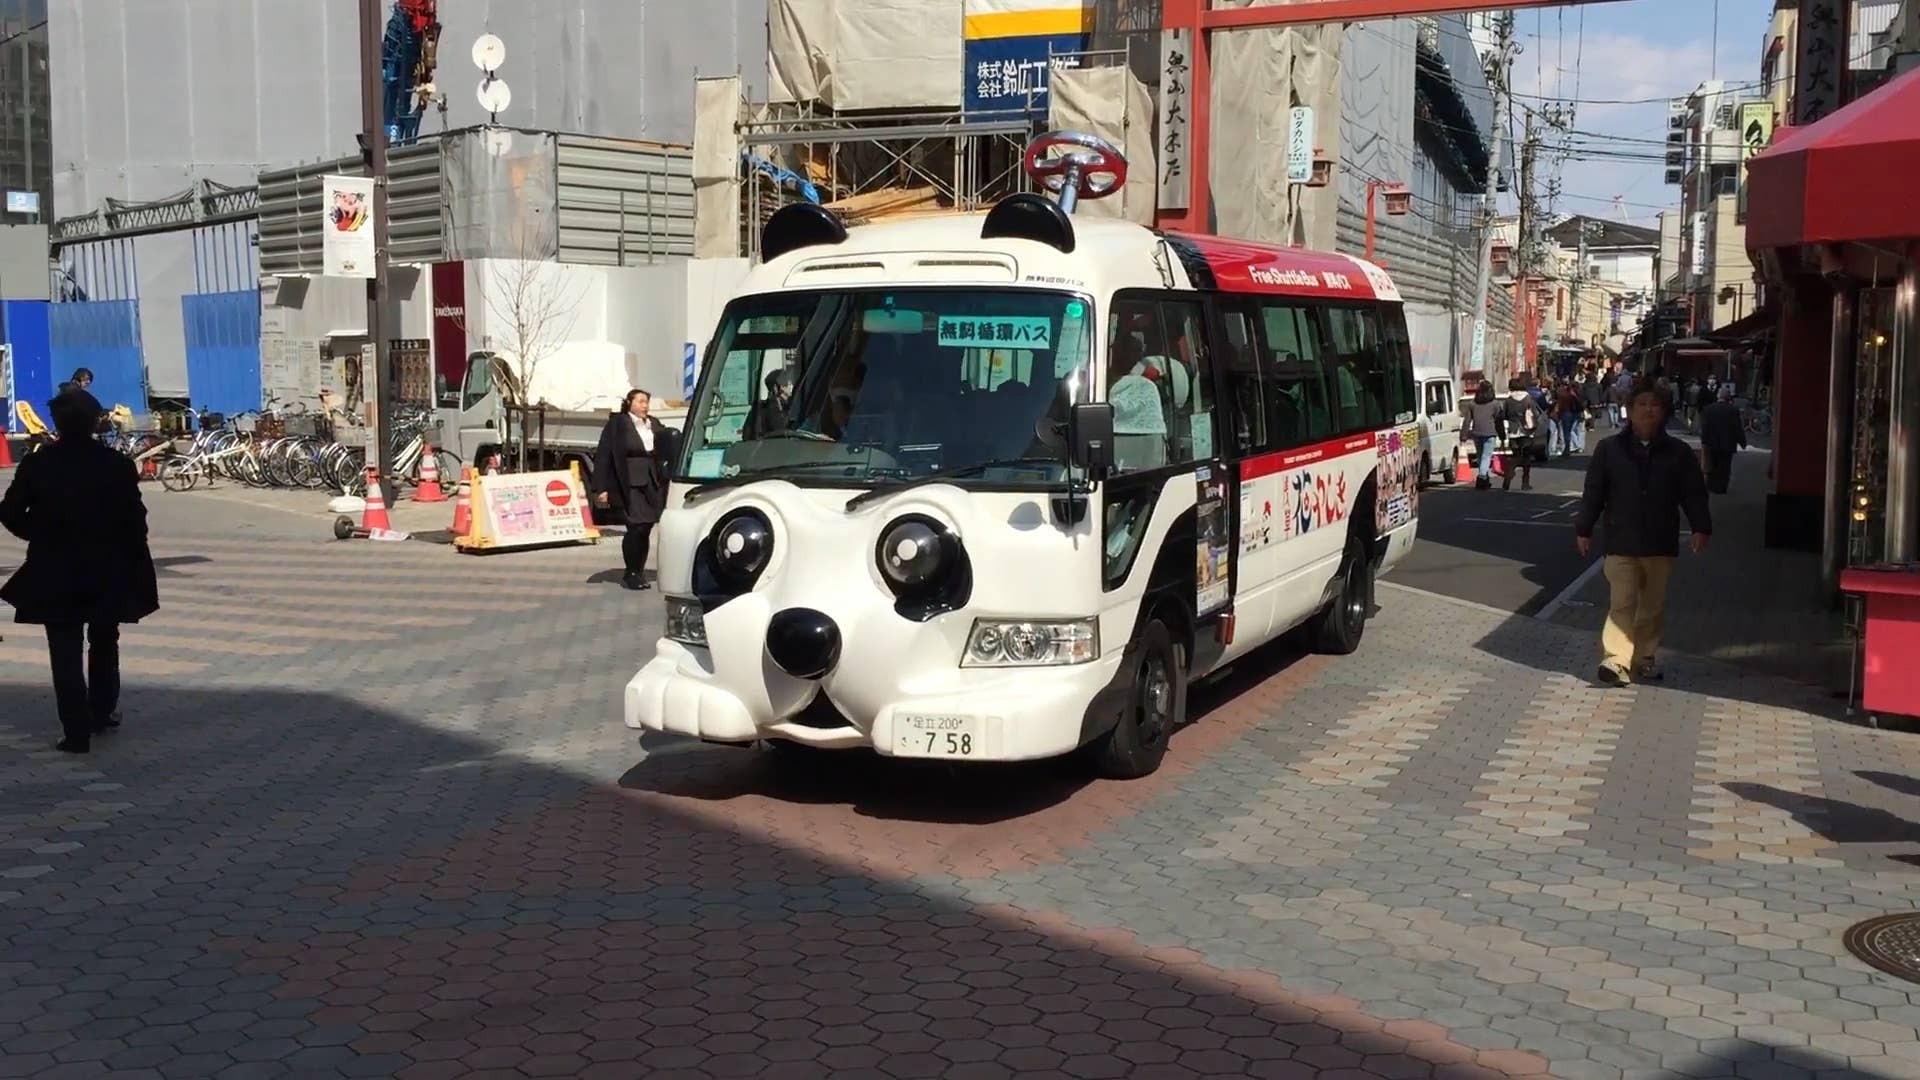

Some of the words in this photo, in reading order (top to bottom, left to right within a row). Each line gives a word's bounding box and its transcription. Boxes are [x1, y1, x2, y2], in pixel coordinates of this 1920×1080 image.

[977, 60, 1001, 79] 株式
[977, 80, 1002, 98] 会社
[1248, 265, 1274, 284] Free
[940, 319, 1048, 342] 無料循環バス
